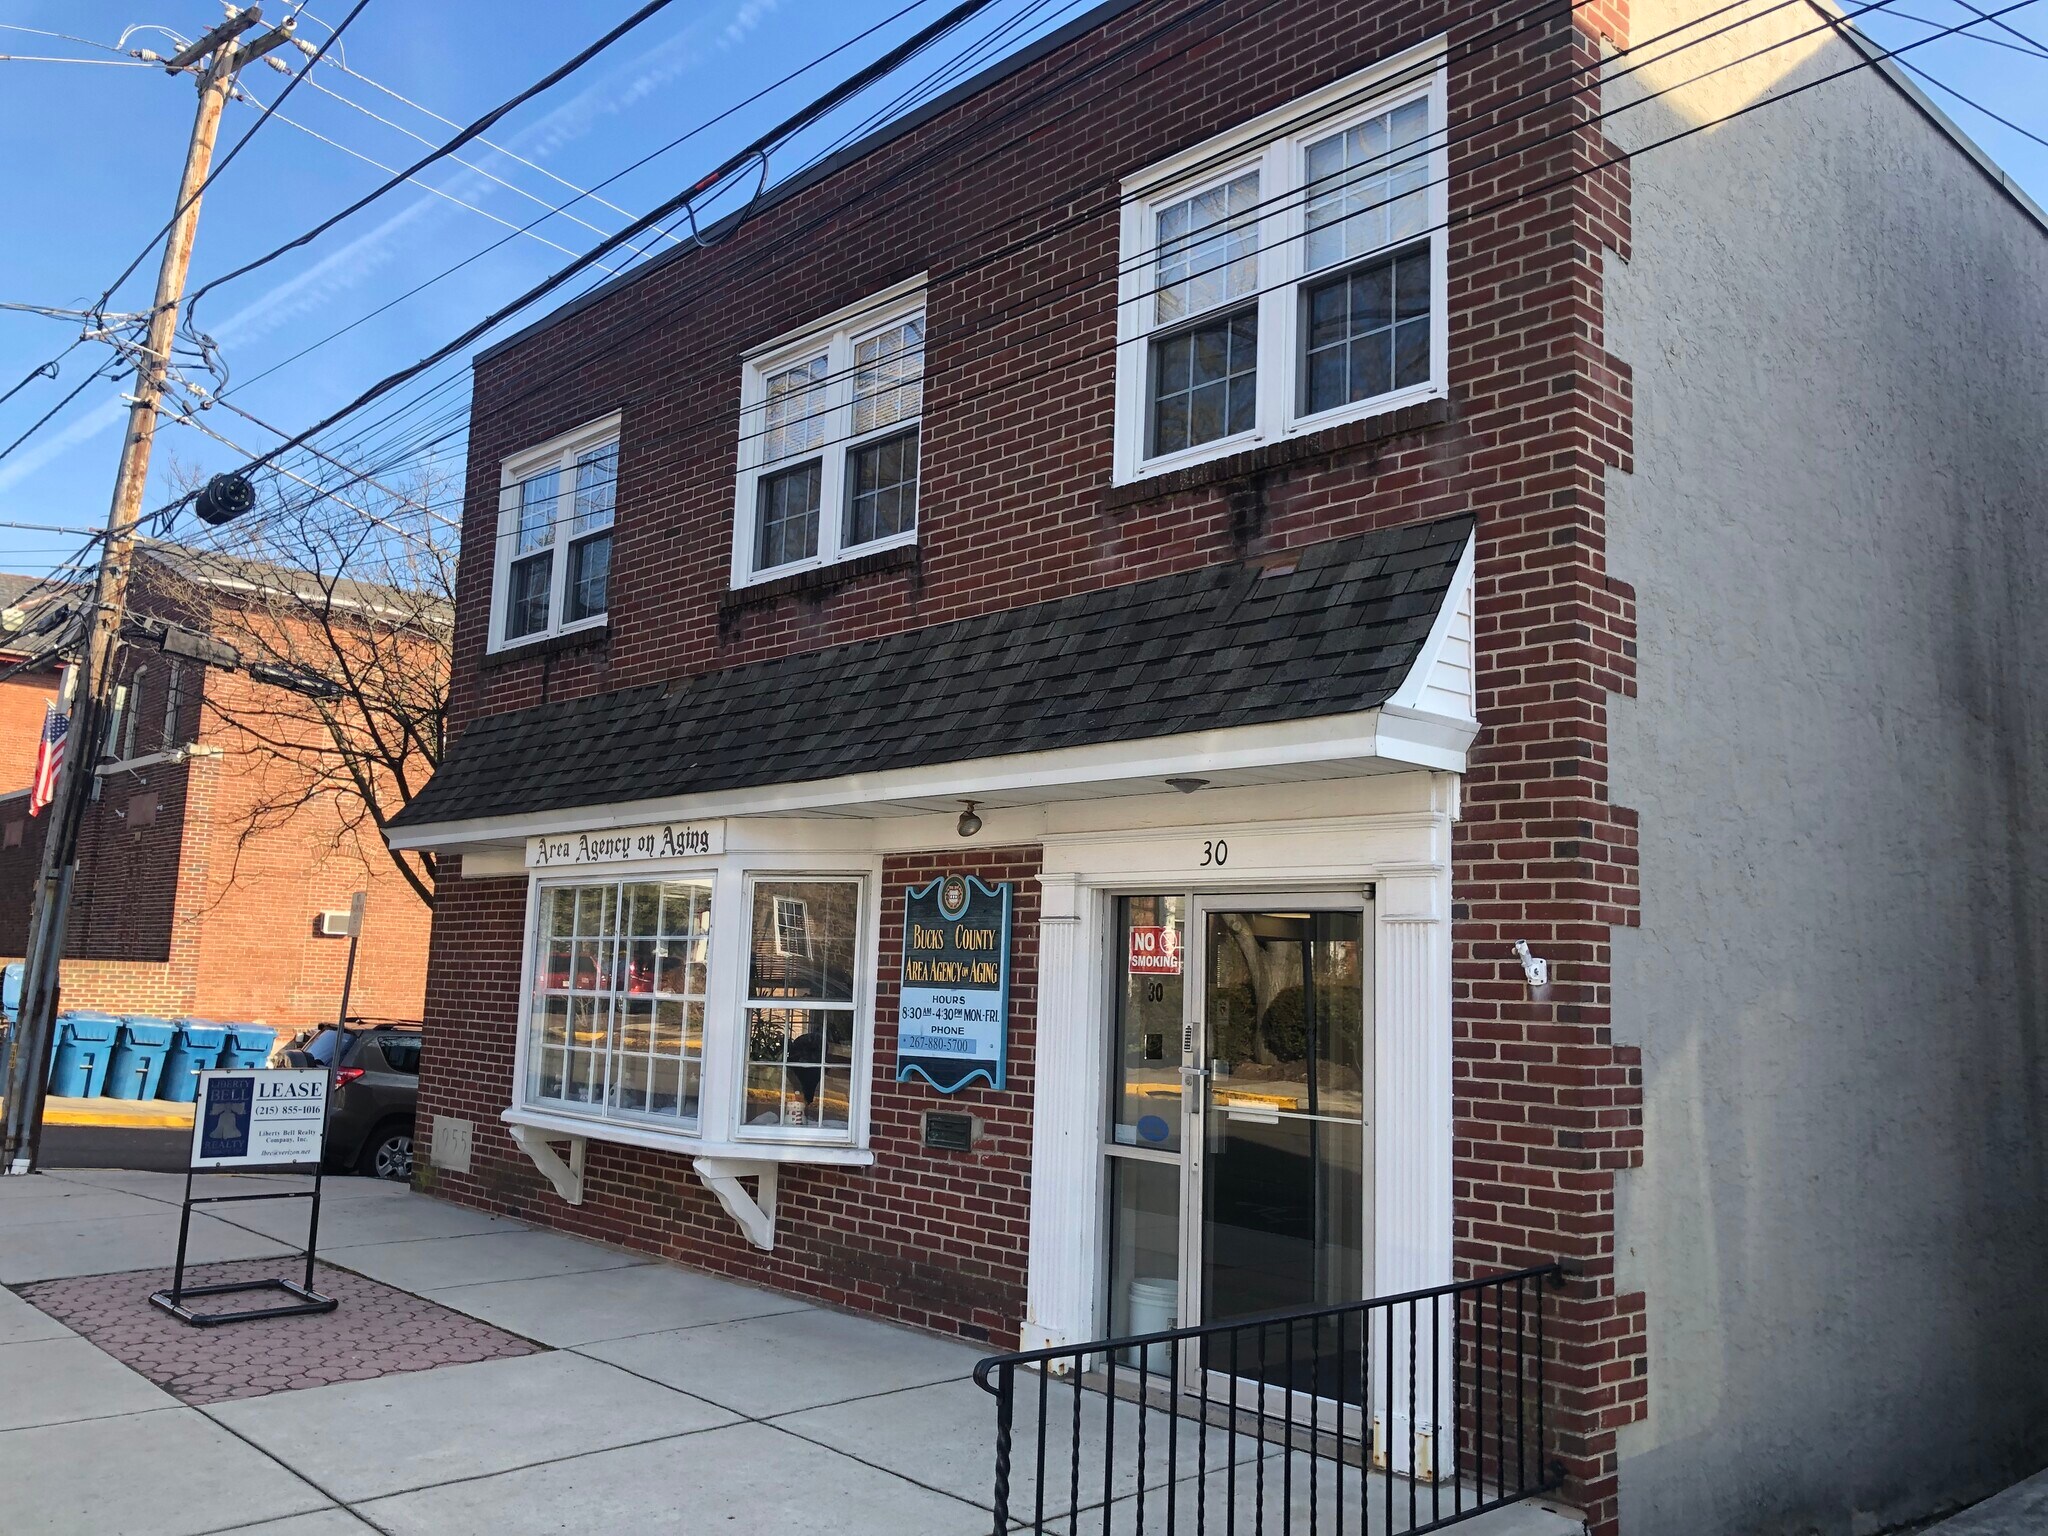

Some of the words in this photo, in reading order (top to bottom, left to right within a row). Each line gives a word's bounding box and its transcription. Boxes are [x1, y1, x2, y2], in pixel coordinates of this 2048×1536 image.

[536, 838, 570, 864] Area
[576, 834, 631, 863] Agency
[637, 833, 655, 858] on
[659, 825, 710, 857] Aging
[1200, 839, 1228, 866] 30
[913, 924, 944, 949] BUCKS
[955, 924, 996, 950] COUNTY
[1134, 932, 1155, 951] NO
[905, 956, 929, 981] AREA
[929, 956, 962, 982] AGENCY
[969, 957, 998, 984] AGING
[1131, 955, 1178, 968] SMOKING
[932, 995, 966, 1005] HOURS
[1148, 982, 1164, 1003] 30
[931, 1025, 965, 1035] PHONE
[909, 1035, 968, 1052] 267-880-5700
[210, 1089, 250, 1101] BELL
[259, 1082, 323, 1098] LEASE
[255, 1106, 279, 1116] (215)
[282, 1105, 321, 1115] 855-1016
